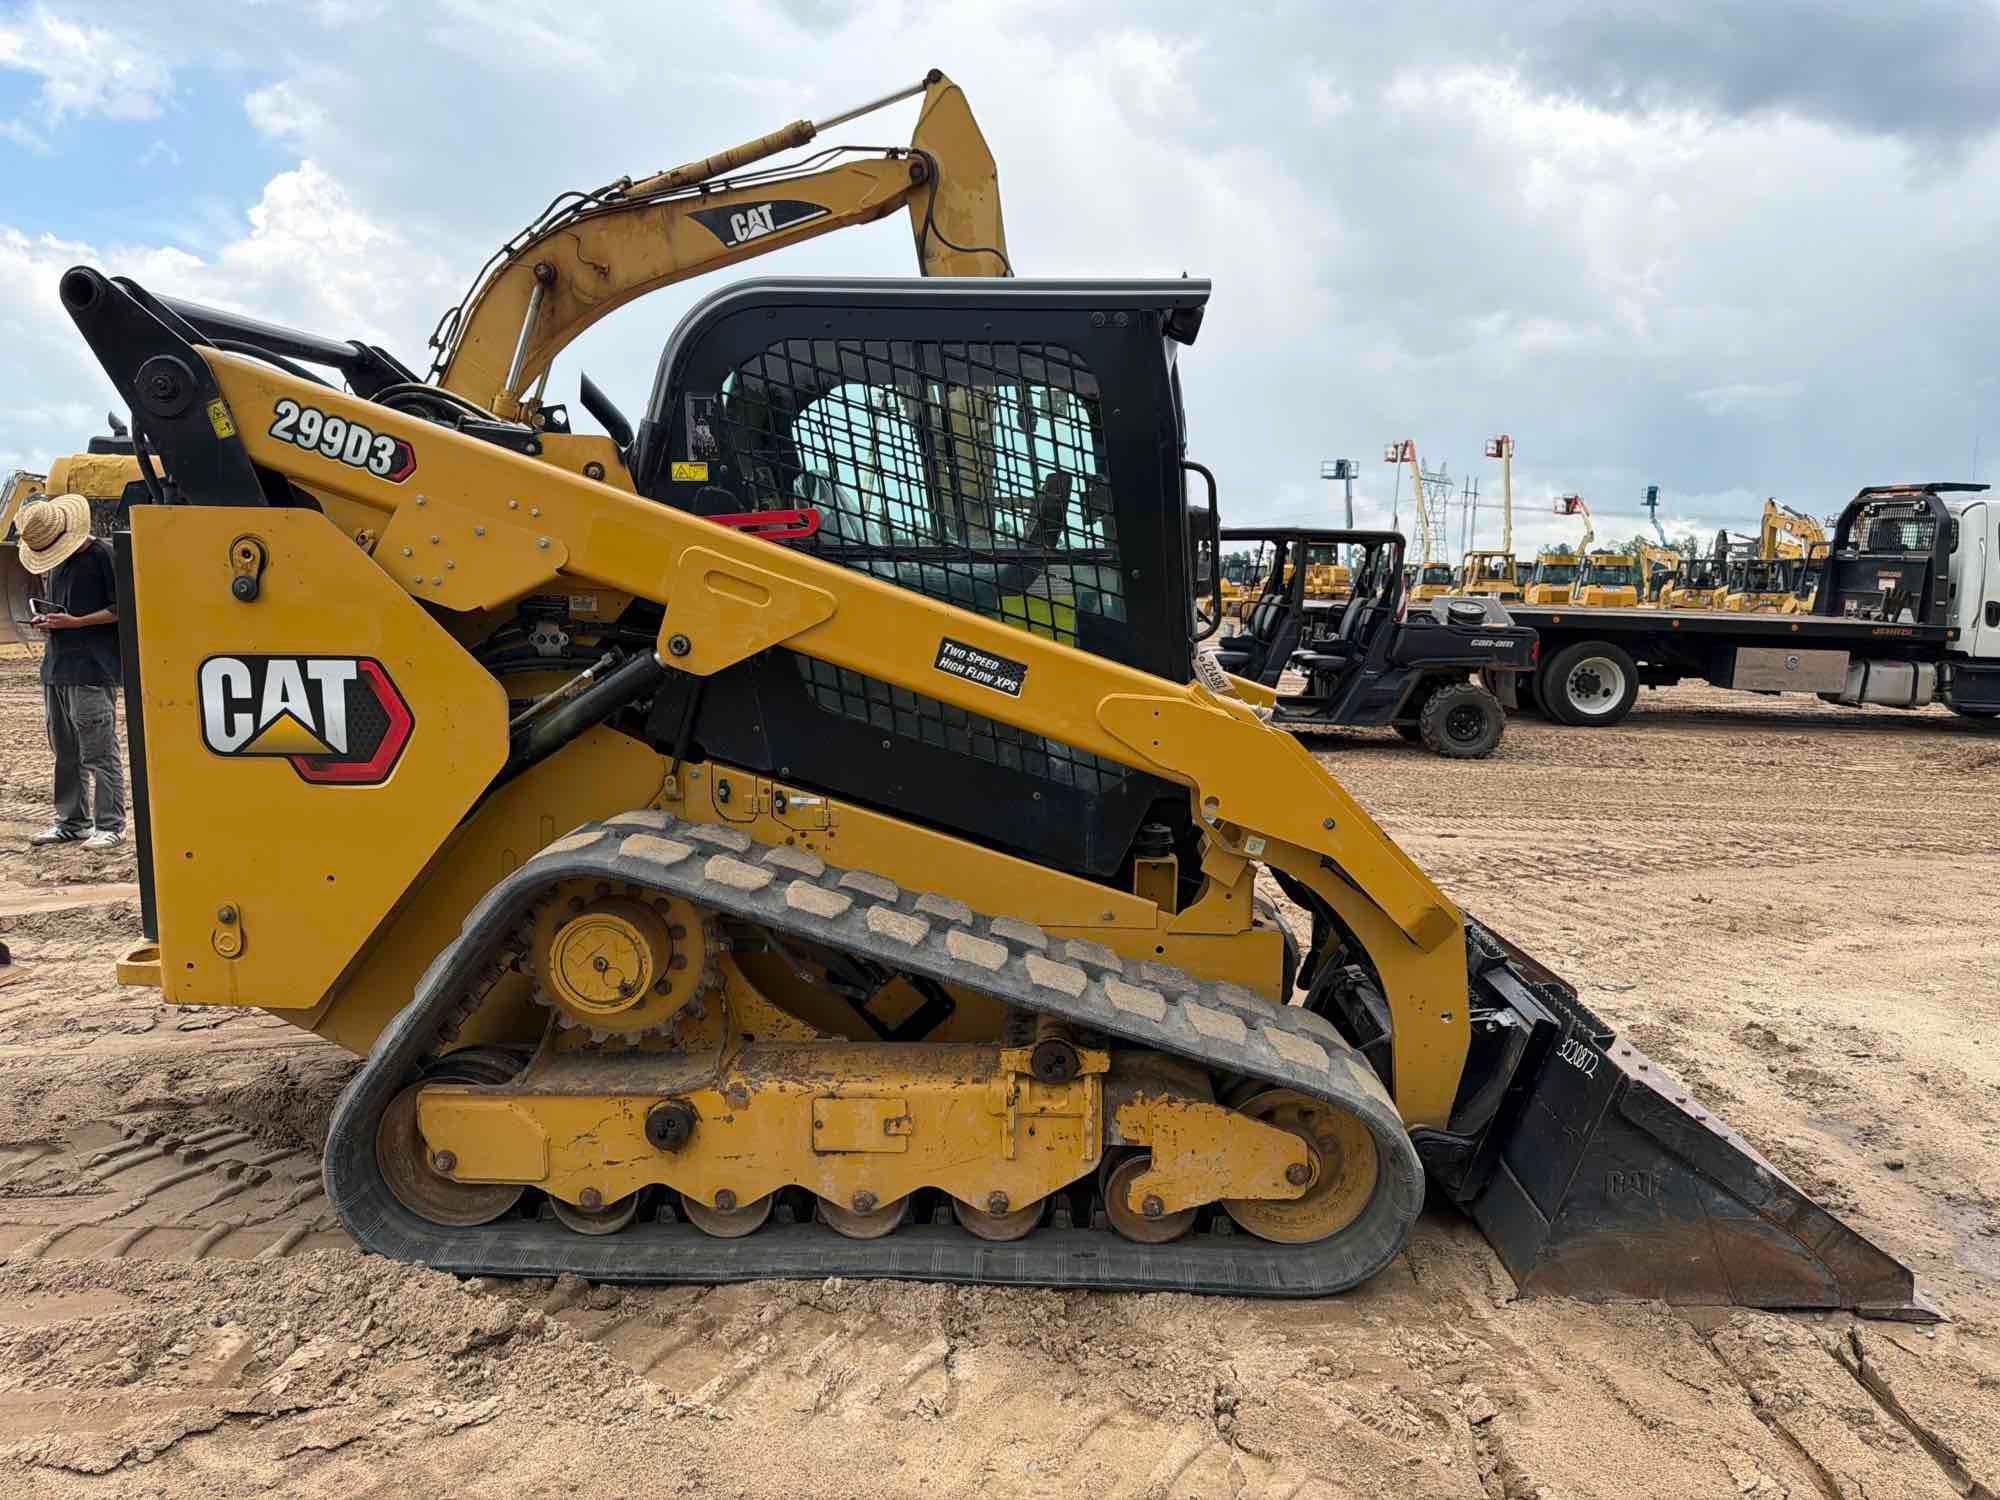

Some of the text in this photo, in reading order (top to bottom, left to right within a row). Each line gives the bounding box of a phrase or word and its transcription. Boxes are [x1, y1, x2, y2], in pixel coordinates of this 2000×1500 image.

[730, 203, 776, 242] CAT
[271, 400, 396, 475] 299D3
[993, 676, 1018, 692] XPS
[201, 657, 358, 754] CAT
[1556, 1038, 1599, 1079] 3220872
